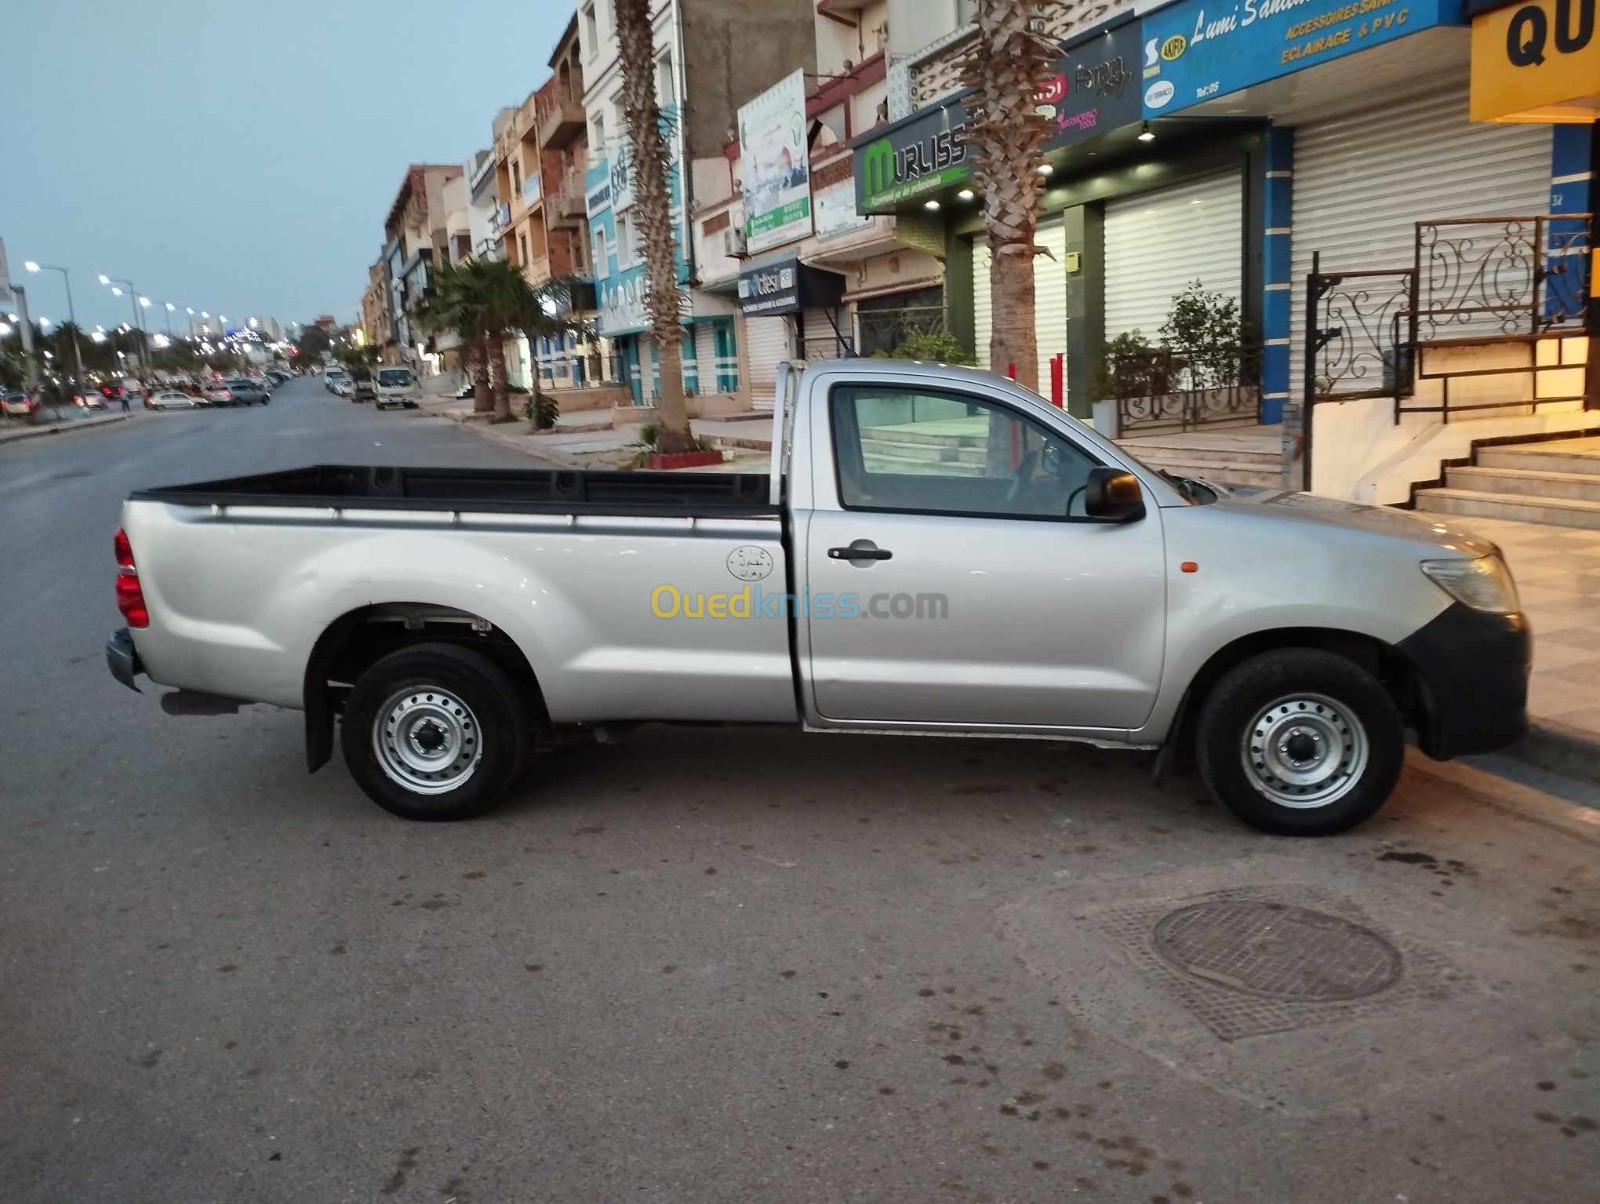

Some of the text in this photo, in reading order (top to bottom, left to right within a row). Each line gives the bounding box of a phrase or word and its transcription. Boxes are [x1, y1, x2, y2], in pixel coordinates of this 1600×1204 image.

[1190, 5, 1239, 47] Lumi
[1281, 28, 1352, 64] ECLAIRAGE
[1358, 22, 1368, 38] &
[1286, 3, 1359, 41] ACCESSOIRES
